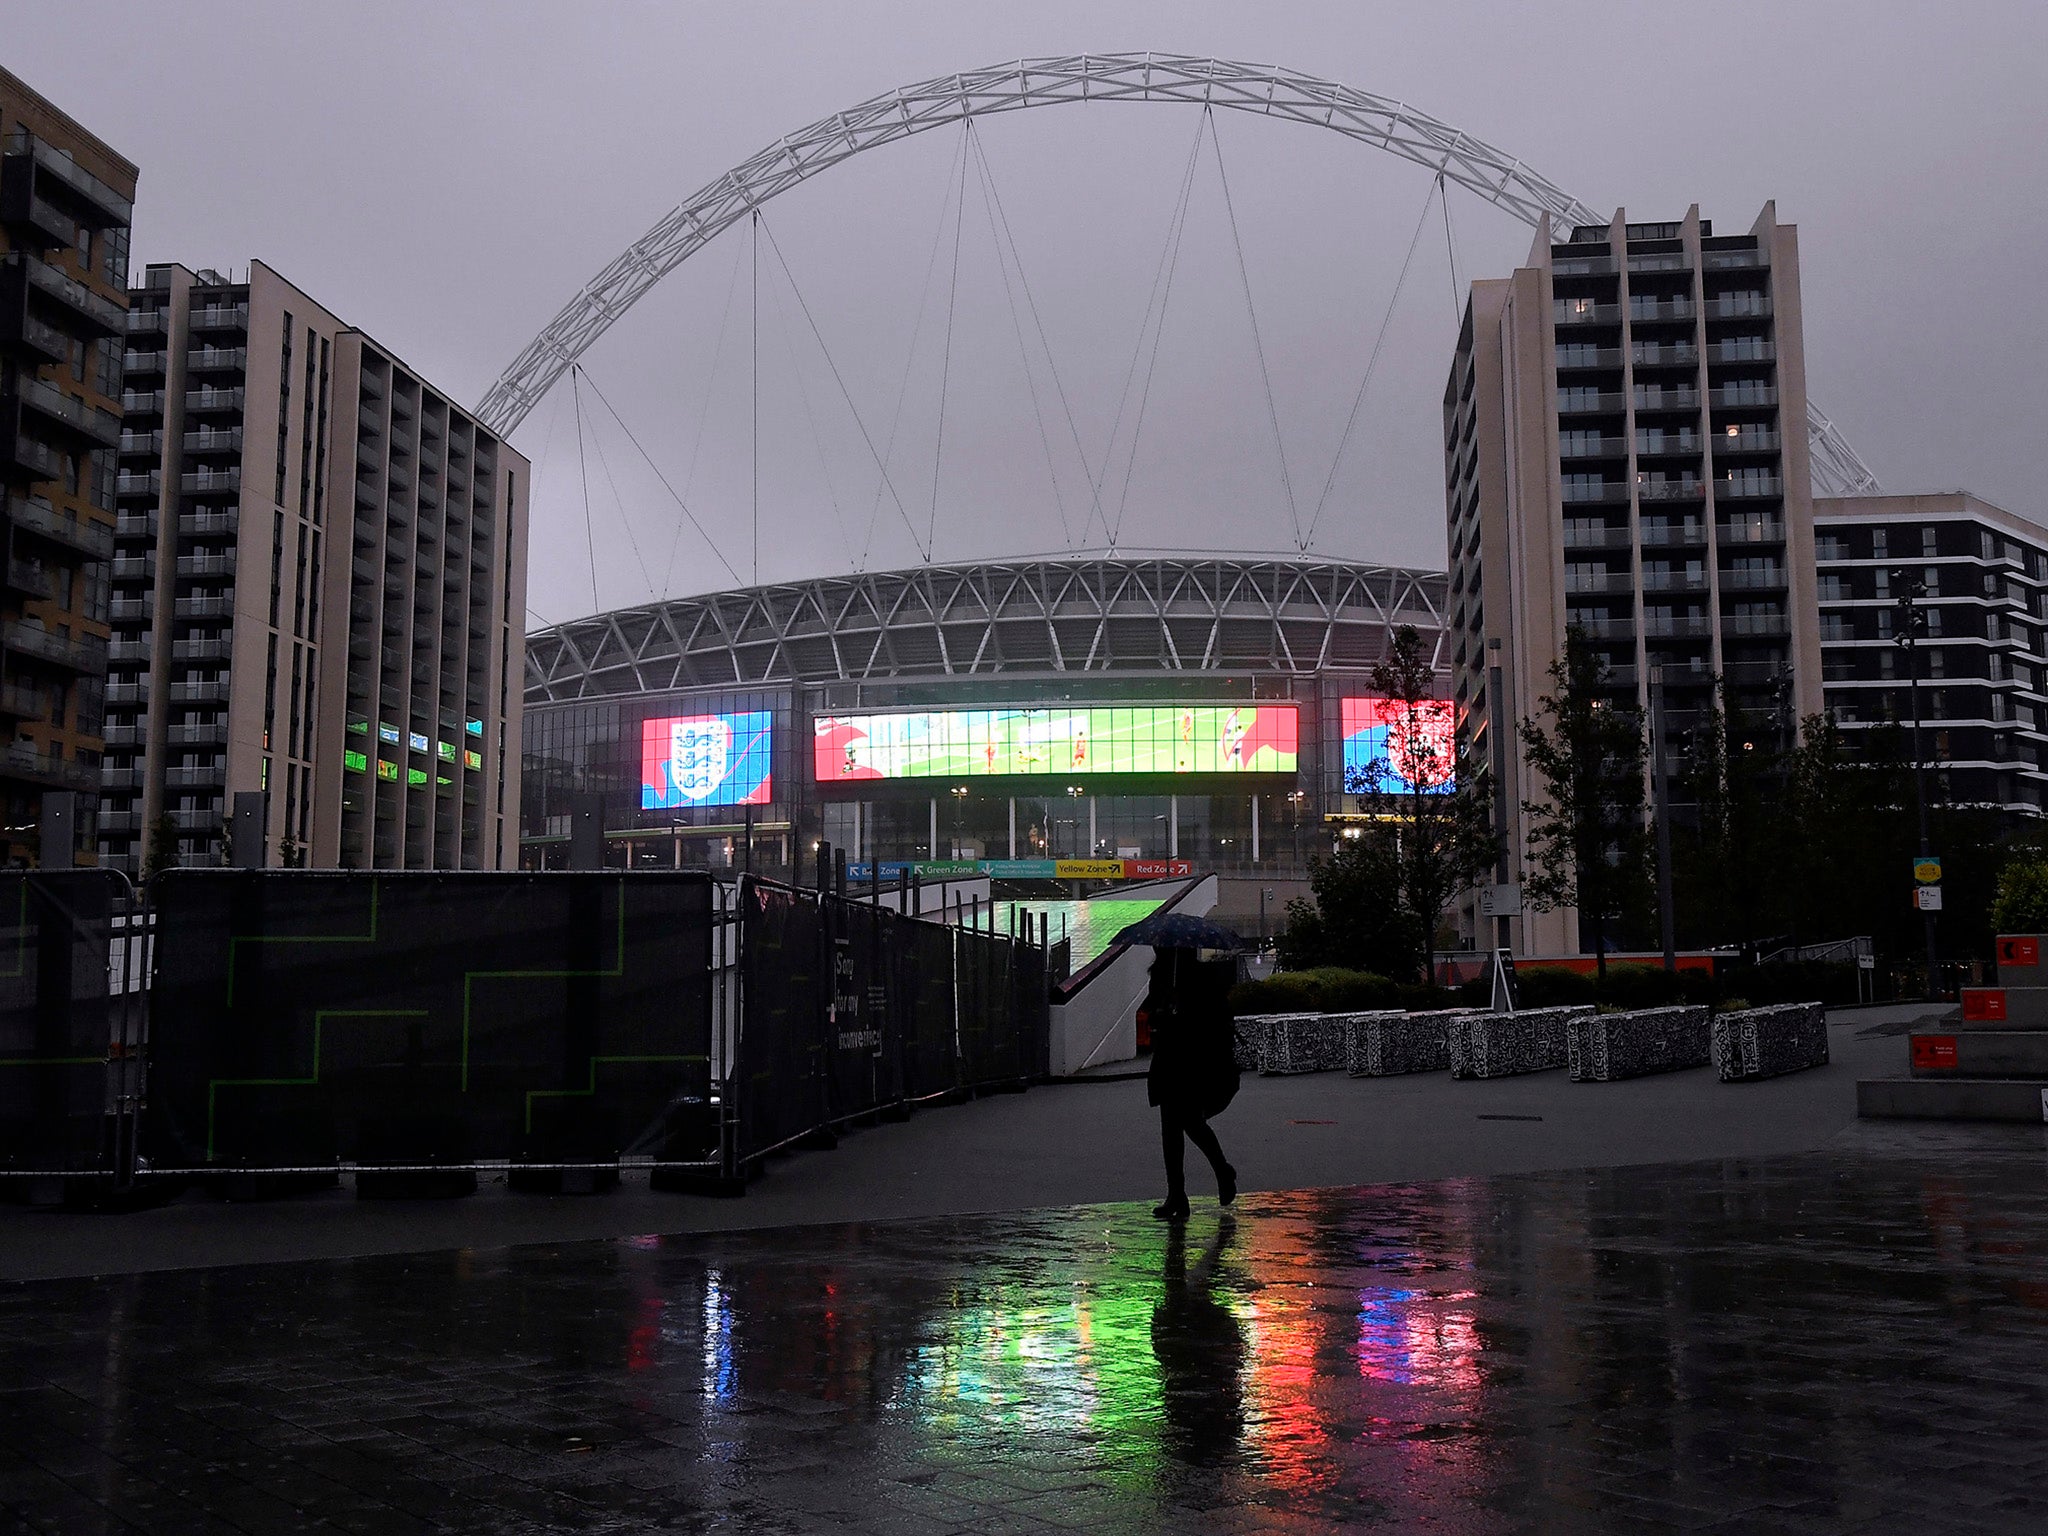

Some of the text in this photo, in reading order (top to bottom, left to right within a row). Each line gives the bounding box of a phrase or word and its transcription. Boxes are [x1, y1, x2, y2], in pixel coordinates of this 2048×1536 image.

[880, 866, 901, 875] Zone
[926, 865, 974, 874] Green Zone
[1059, 864, 1085, 873] Yellow
[1086, 865, 1108, 873] Zone
[1136, 865, 1153, 873] Red
